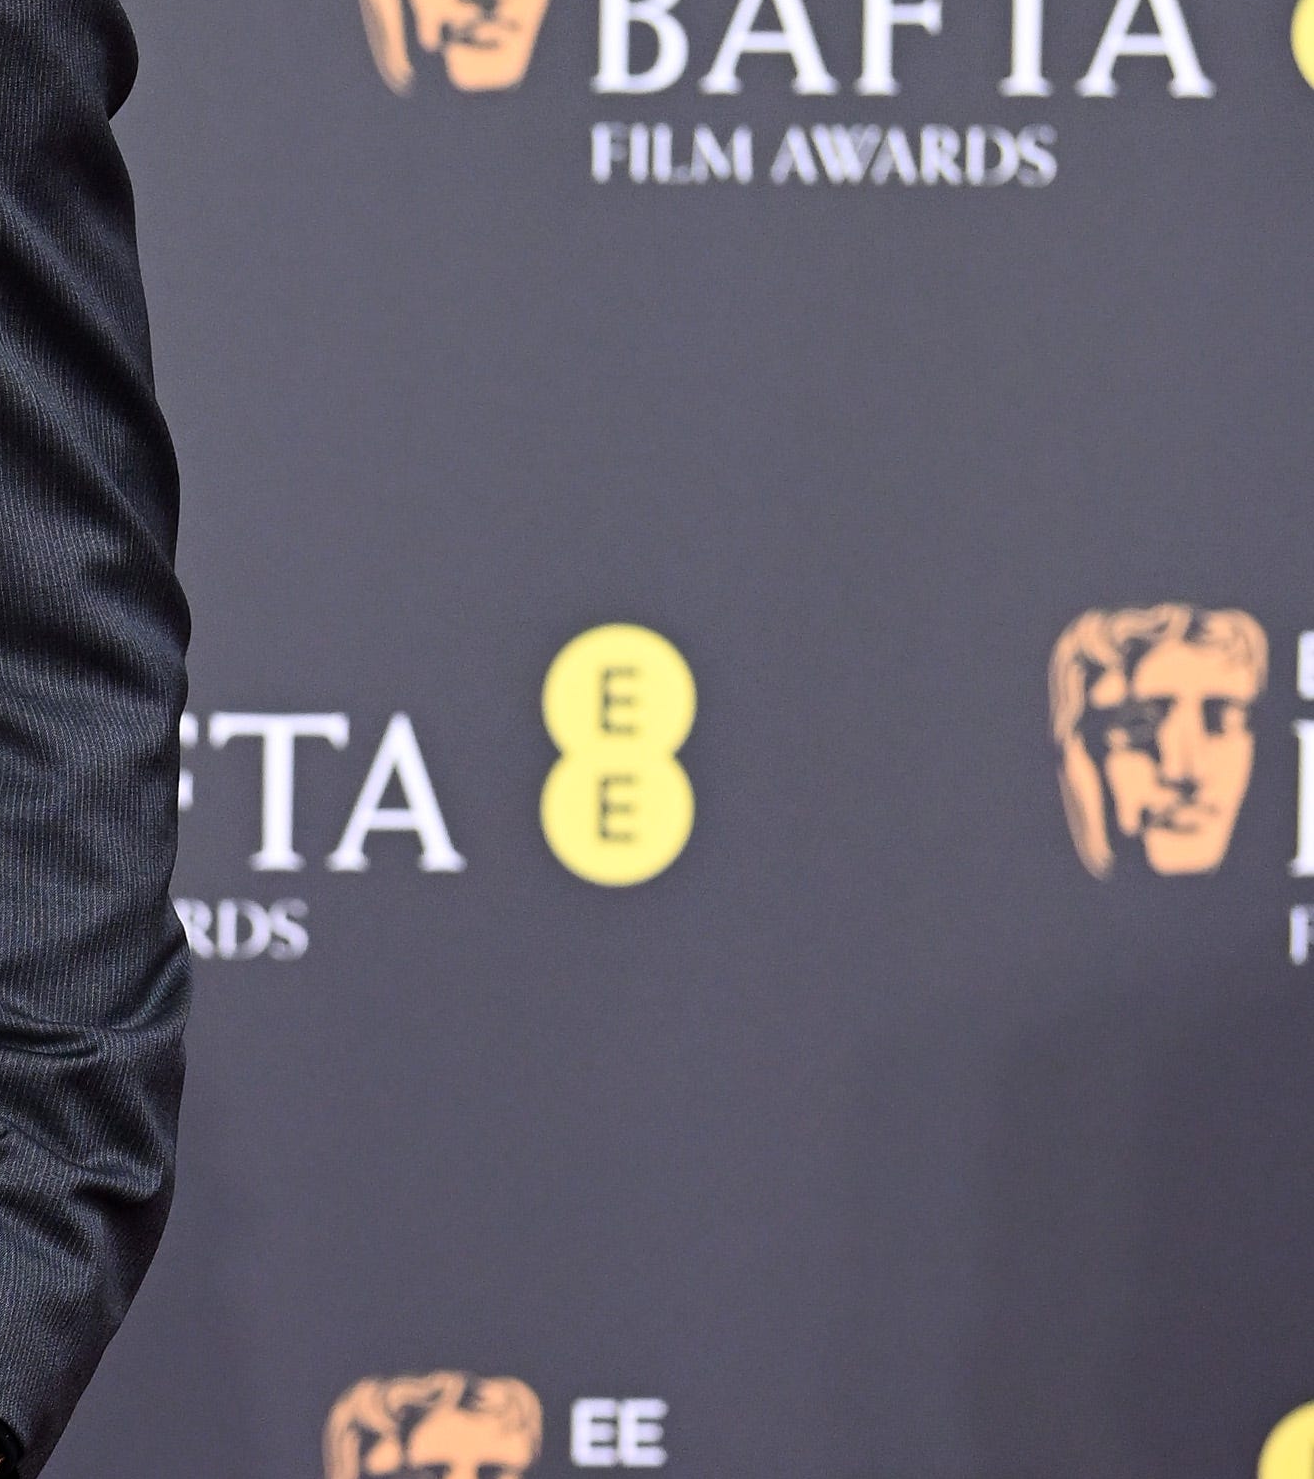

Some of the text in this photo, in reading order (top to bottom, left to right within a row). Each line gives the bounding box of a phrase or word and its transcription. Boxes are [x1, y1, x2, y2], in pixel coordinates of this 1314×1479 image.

[591, 123, 1057, 185] FILM AWARDS
[570, 1398, 667, 1467] EE
